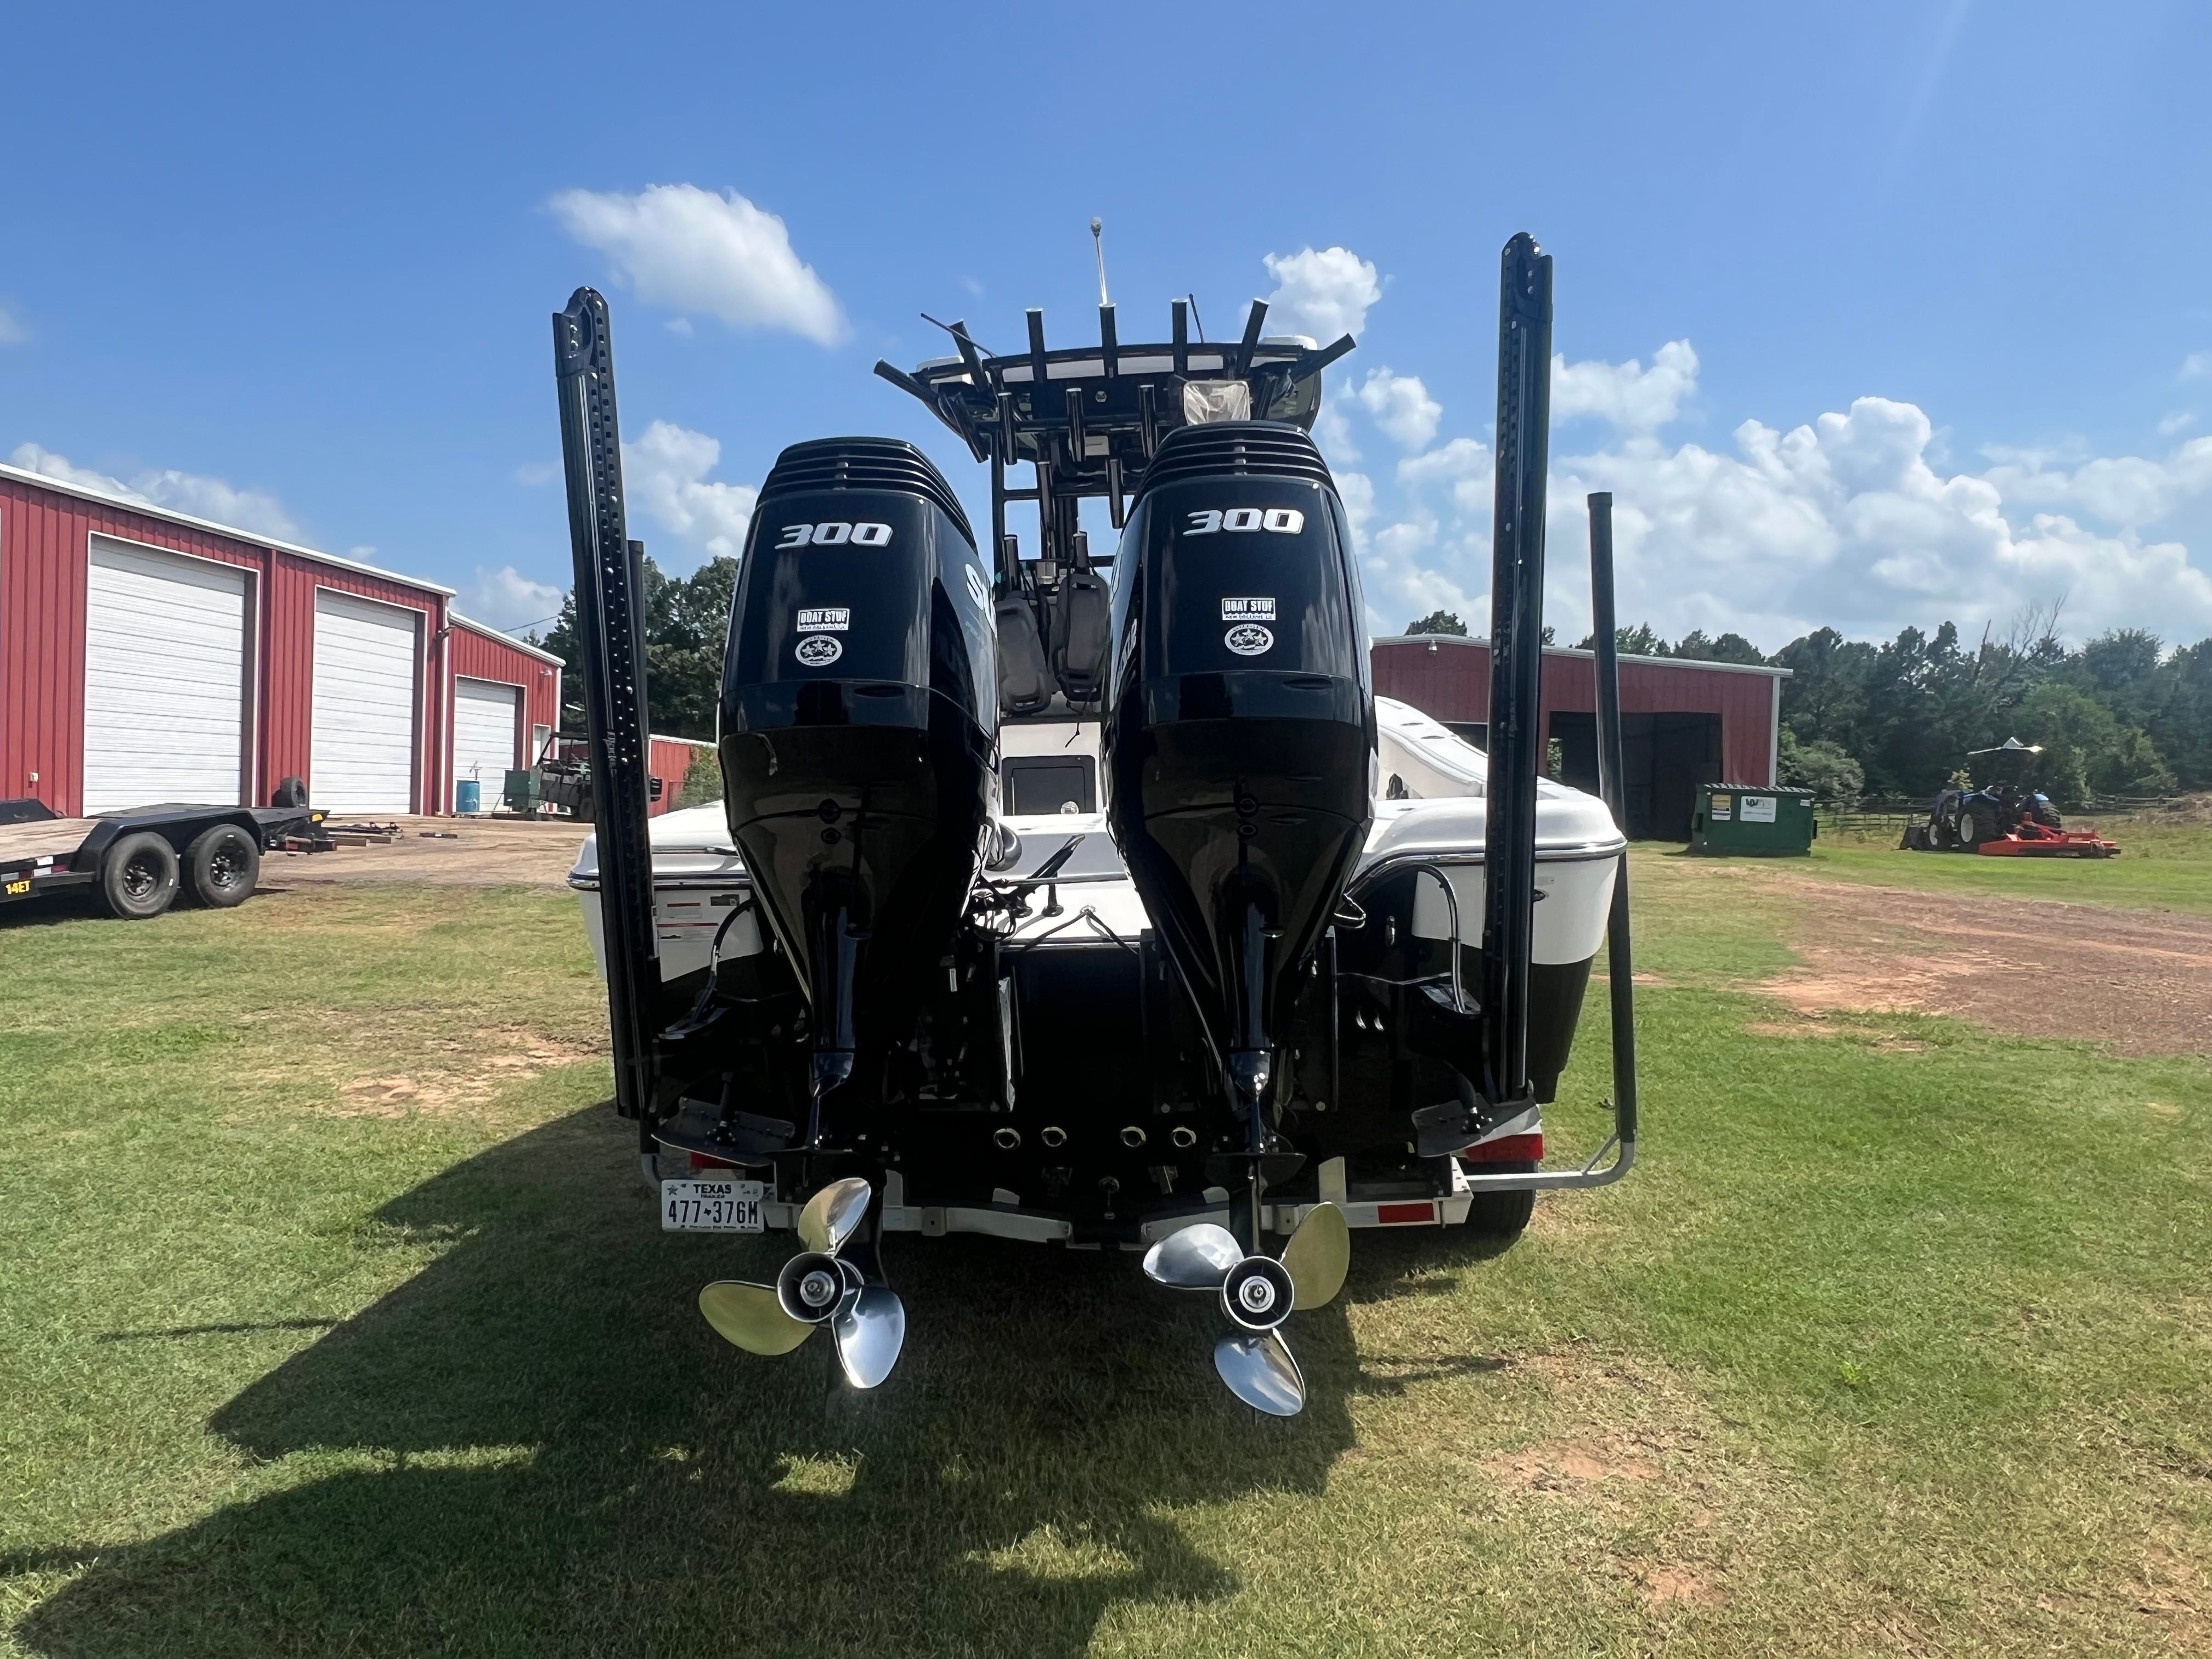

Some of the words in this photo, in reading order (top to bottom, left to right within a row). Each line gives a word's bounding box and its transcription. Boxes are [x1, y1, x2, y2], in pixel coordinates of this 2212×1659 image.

[1183, 508, 1305, 536] 300
[775, 523, 893, 549] 300
[1225, 600, 1248, 612] BOAT
[693, 1184, 732, 1194] TEXAS
